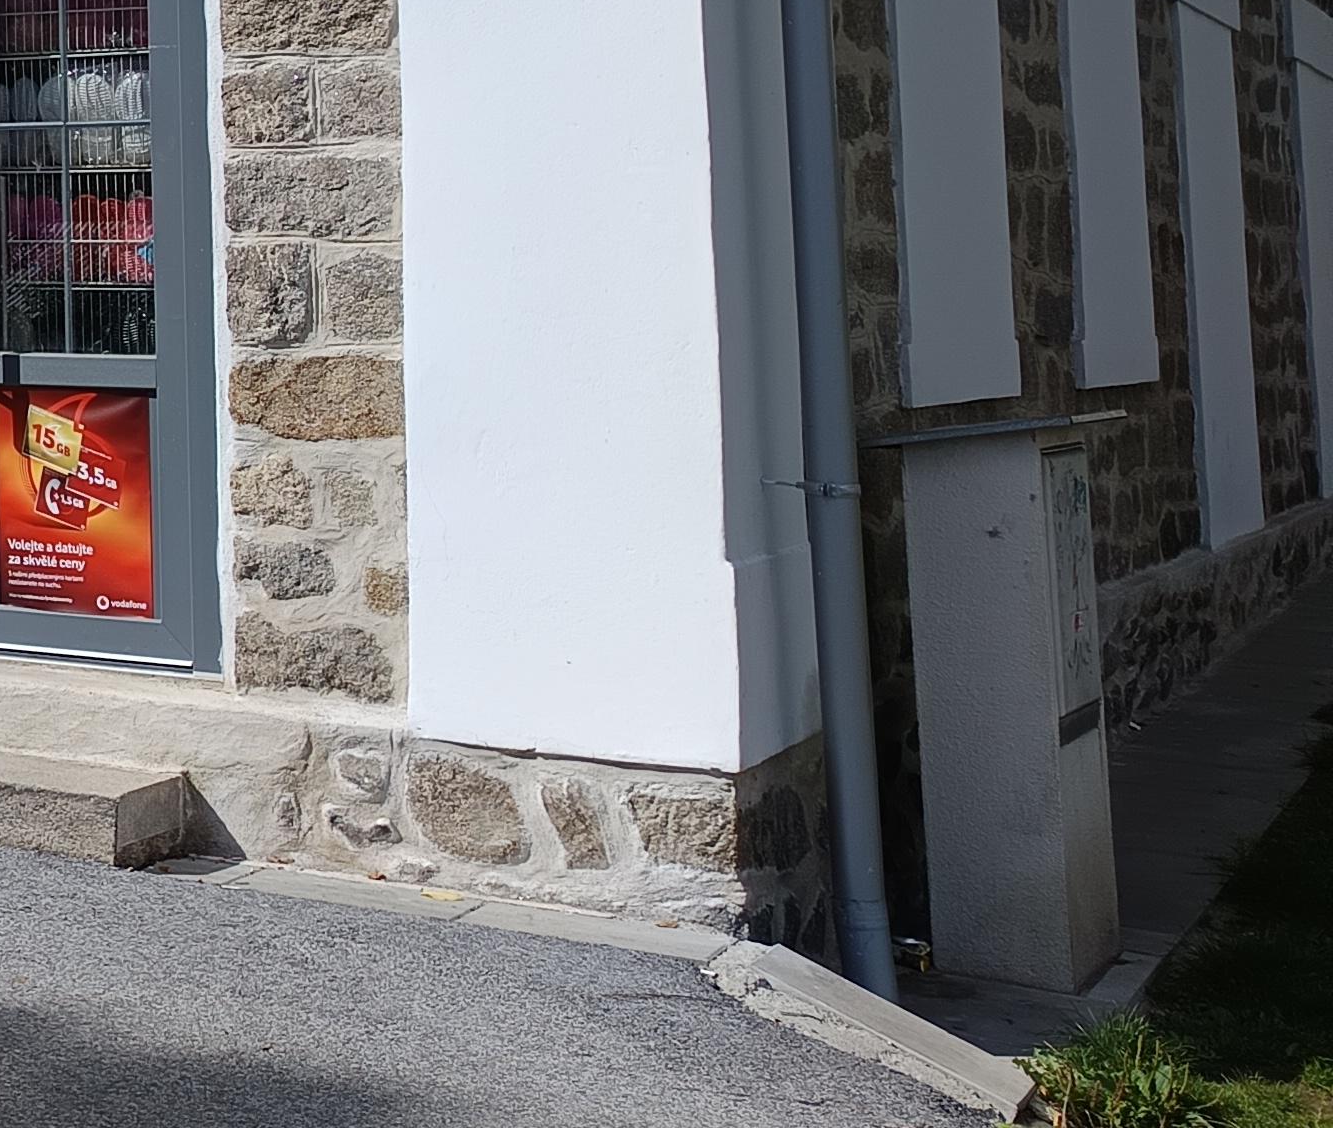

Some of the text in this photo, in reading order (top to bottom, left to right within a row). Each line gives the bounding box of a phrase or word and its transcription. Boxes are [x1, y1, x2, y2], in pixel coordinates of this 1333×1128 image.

[32, 423, 71, 457] 15 GB
[105, 478, 118, 490] GB
[7, 537, 94, 557] Volejte a datujte
[8, 554, 86, 572] za skvělé ceny
[111, 599, 148, 610] vodafone
